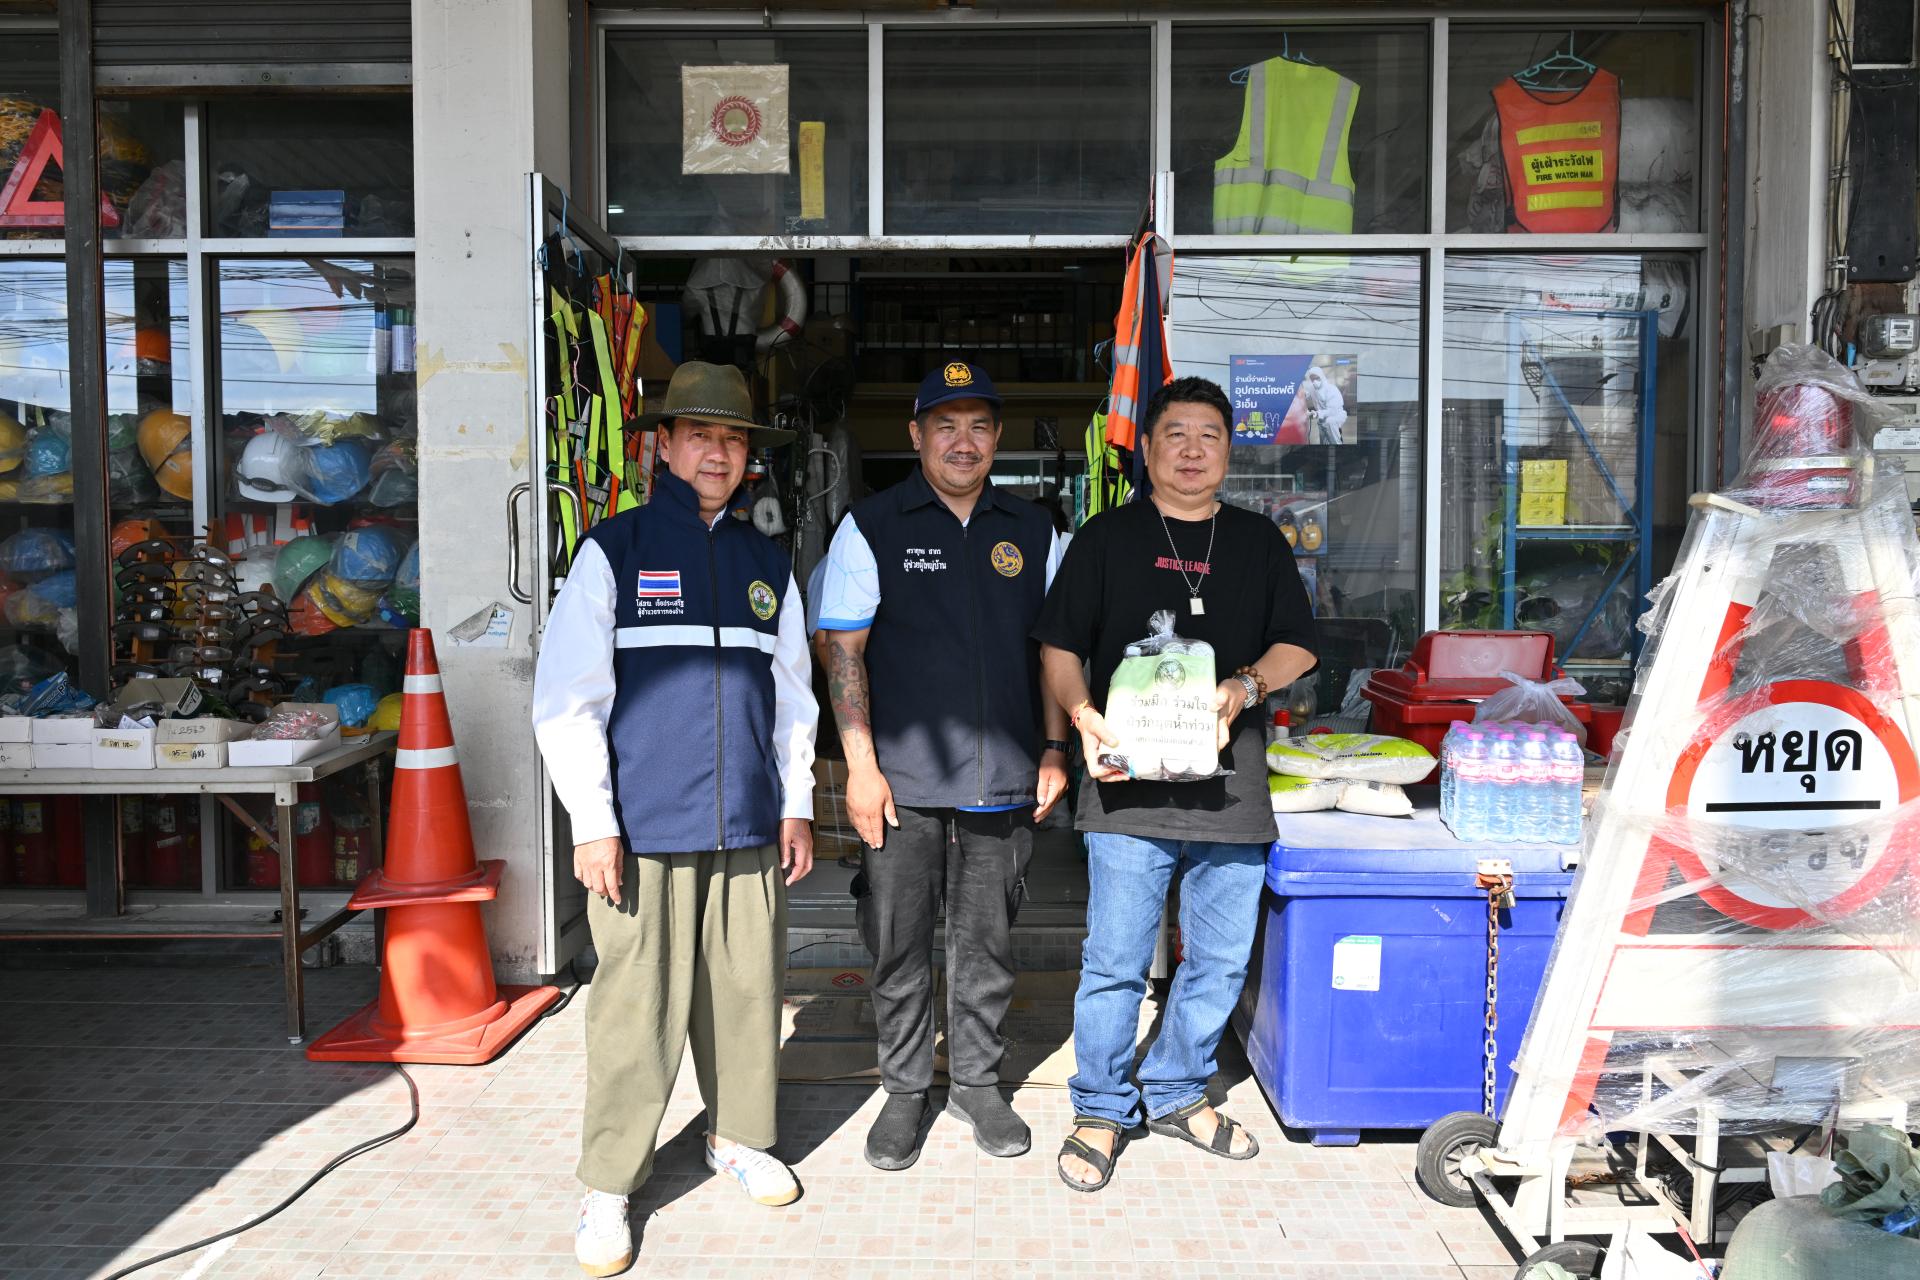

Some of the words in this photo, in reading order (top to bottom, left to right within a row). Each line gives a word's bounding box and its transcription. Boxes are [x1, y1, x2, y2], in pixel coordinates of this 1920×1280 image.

[1530, 154, 1594, 173] ผู้เฝ้าระวังไฟ
[1536, 173, 1552, 182] FIRE
[1555, 172, 1578, 180] WATCH
[1580, 171, 1594, 179] MAN
[1235, 373, 1276, 383] ร้านนี้จำหน่าย
[1235, 398, 1257, 408] 3เอ็ม
[1155, 556, 1184, 571] JUSTICE
[1185, 560, 1211, 575] LEAGUE
[1173, 695, 1208, 710] ร่วมใจ
[1733, 729, 1863, 794] หยุด
